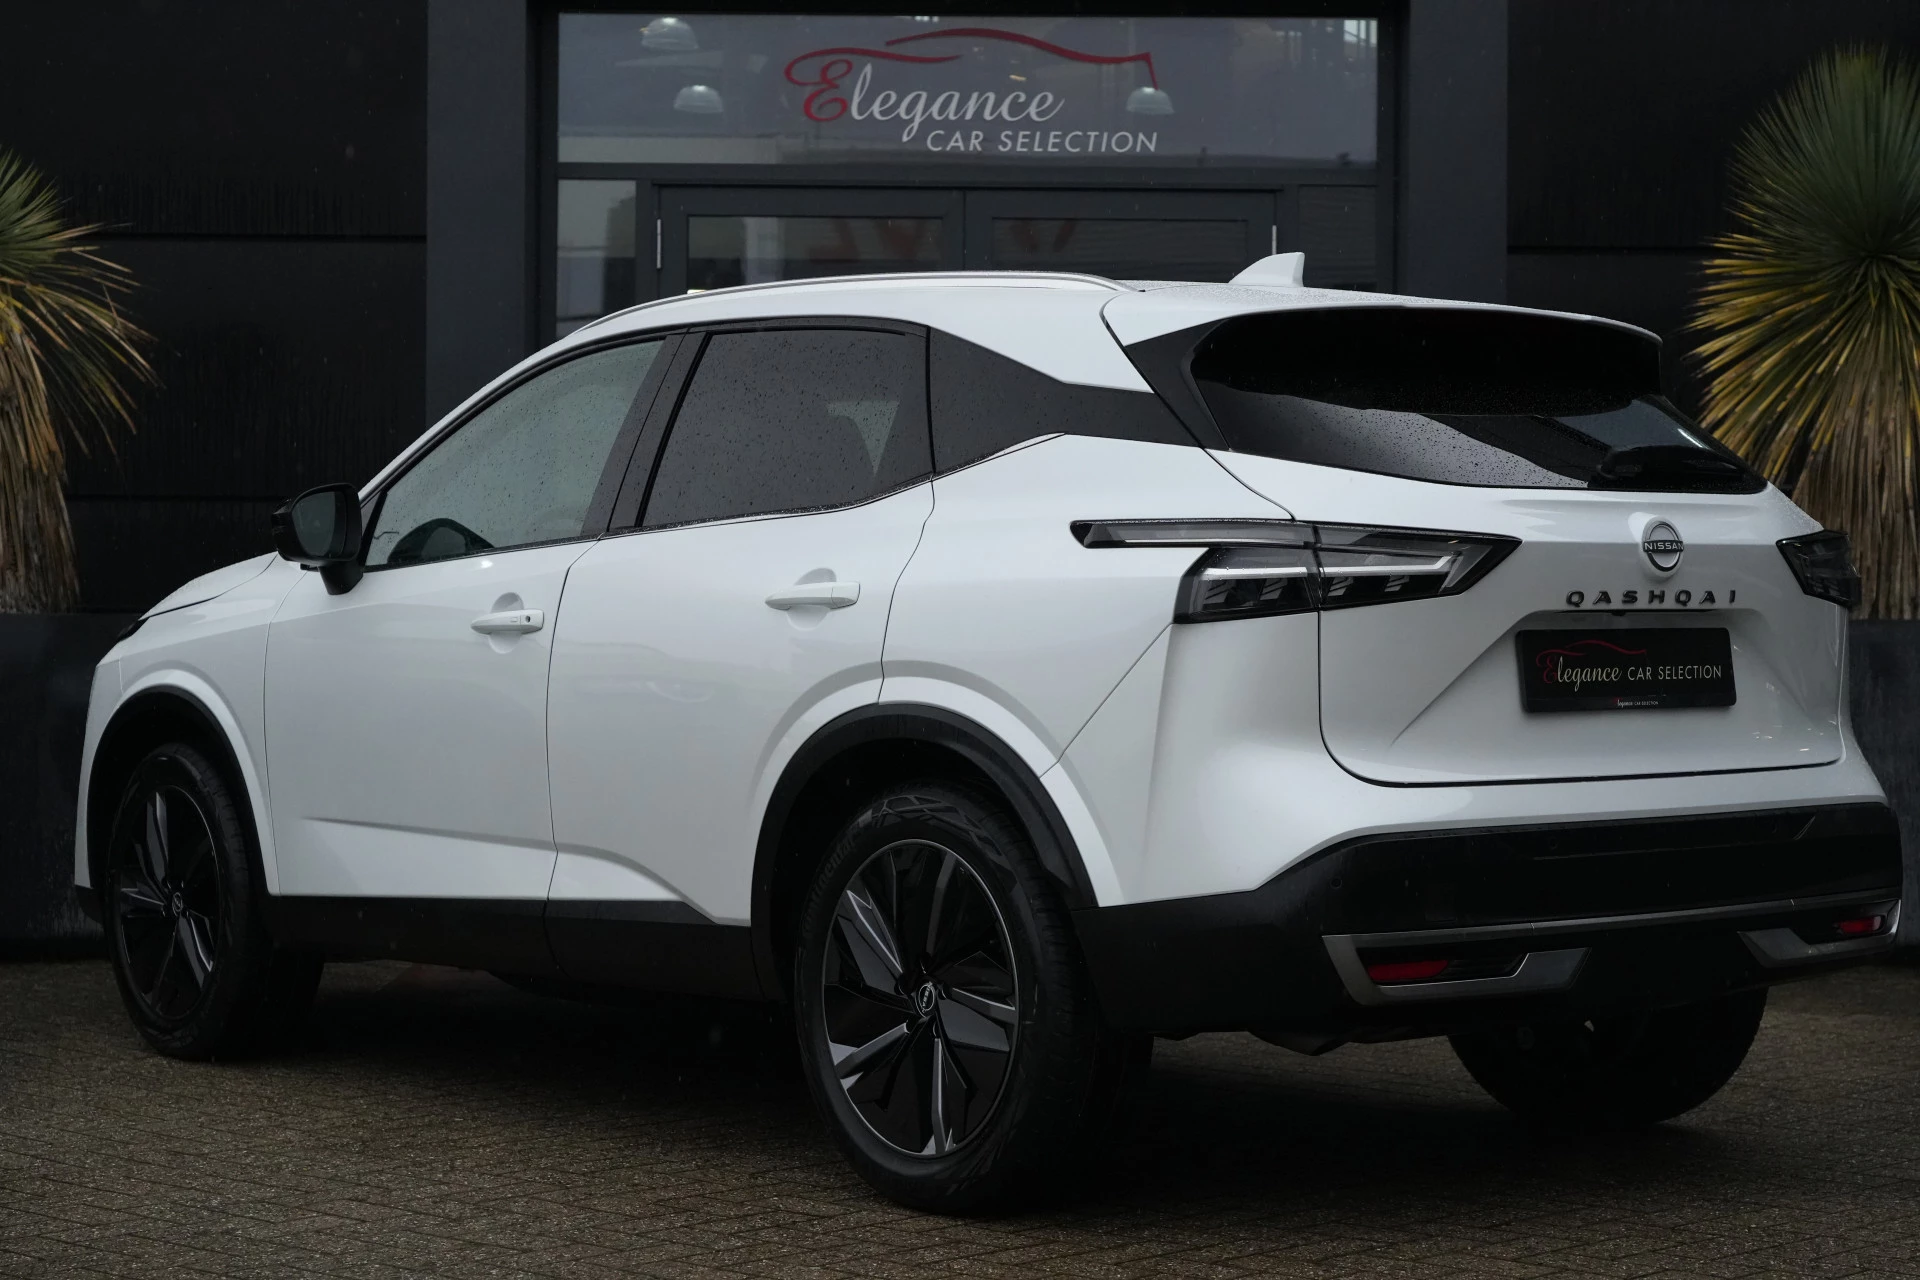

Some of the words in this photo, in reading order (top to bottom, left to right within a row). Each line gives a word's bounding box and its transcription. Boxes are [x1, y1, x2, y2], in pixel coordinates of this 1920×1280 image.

[785, 54, 1065, 142] Elegance
[926, 129, 984, 152] CAR
[997, 129, 1158, 153] SELECTION
[1643, 541, 1684, 551] NISSAN
[1566, 589, 1737, 607] QASHQAI
[1536, 651, 1622, 691] Elegance
[1627, 666, 1652, 681] CAR
[1658, 665, 1722, 680] SELECTION
